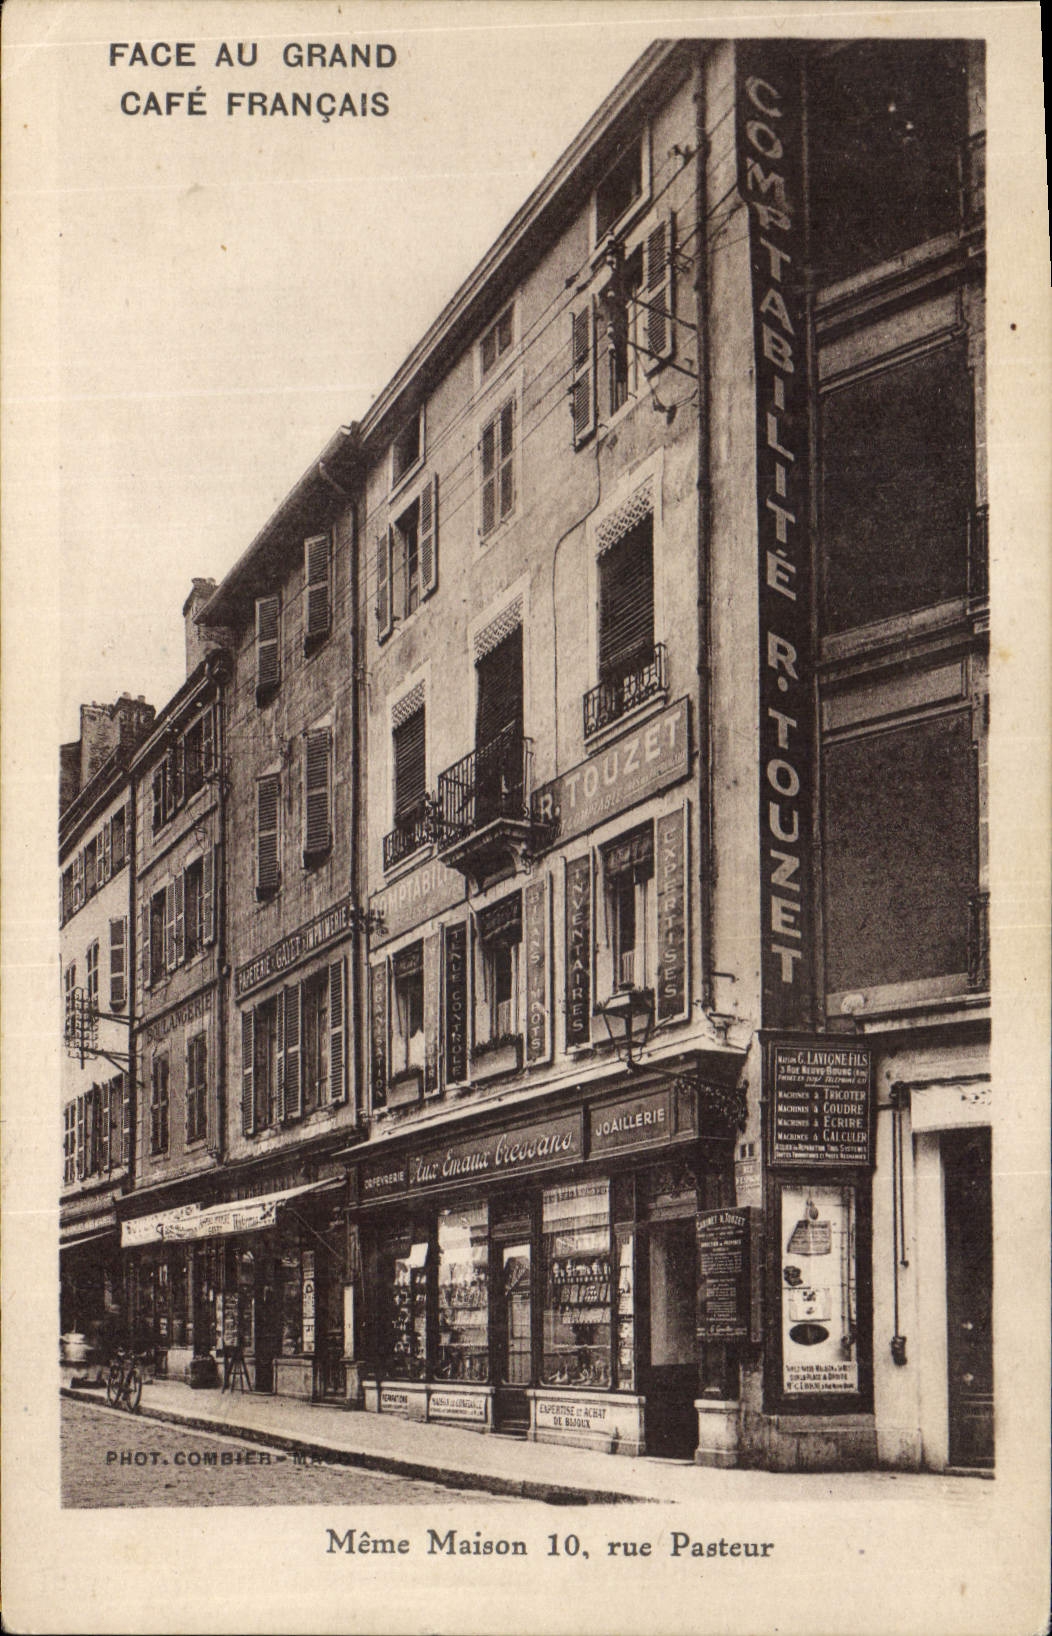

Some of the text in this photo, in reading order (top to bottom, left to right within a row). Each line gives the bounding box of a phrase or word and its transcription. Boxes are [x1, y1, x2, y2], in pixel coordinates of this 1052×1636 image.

[565, 710, 682, 809] TOUZET
[766, 707, 802, 985] TOUZET
[663, 827, 677, 999] EXPERTISES
[571, 869, 585, 1032] INVENTAIRES
[849, 1052, 868, 1066] FILS
[824, 1088, 866, 1100] TRICOTER
[823, 1101, 864, 1115] COUDRE
[595, 1107, 666, 1137] JOAILLERIE
[823, 1129, 867, 1142] CALCULER
[409, 1155, 438, 1185] Aux
[539, 1403, 575, 1416] EXPERTISE
[584, 1407, 606, 1419] ACHAT
[553, 1416, 591, 1429] DE BIJOUX
